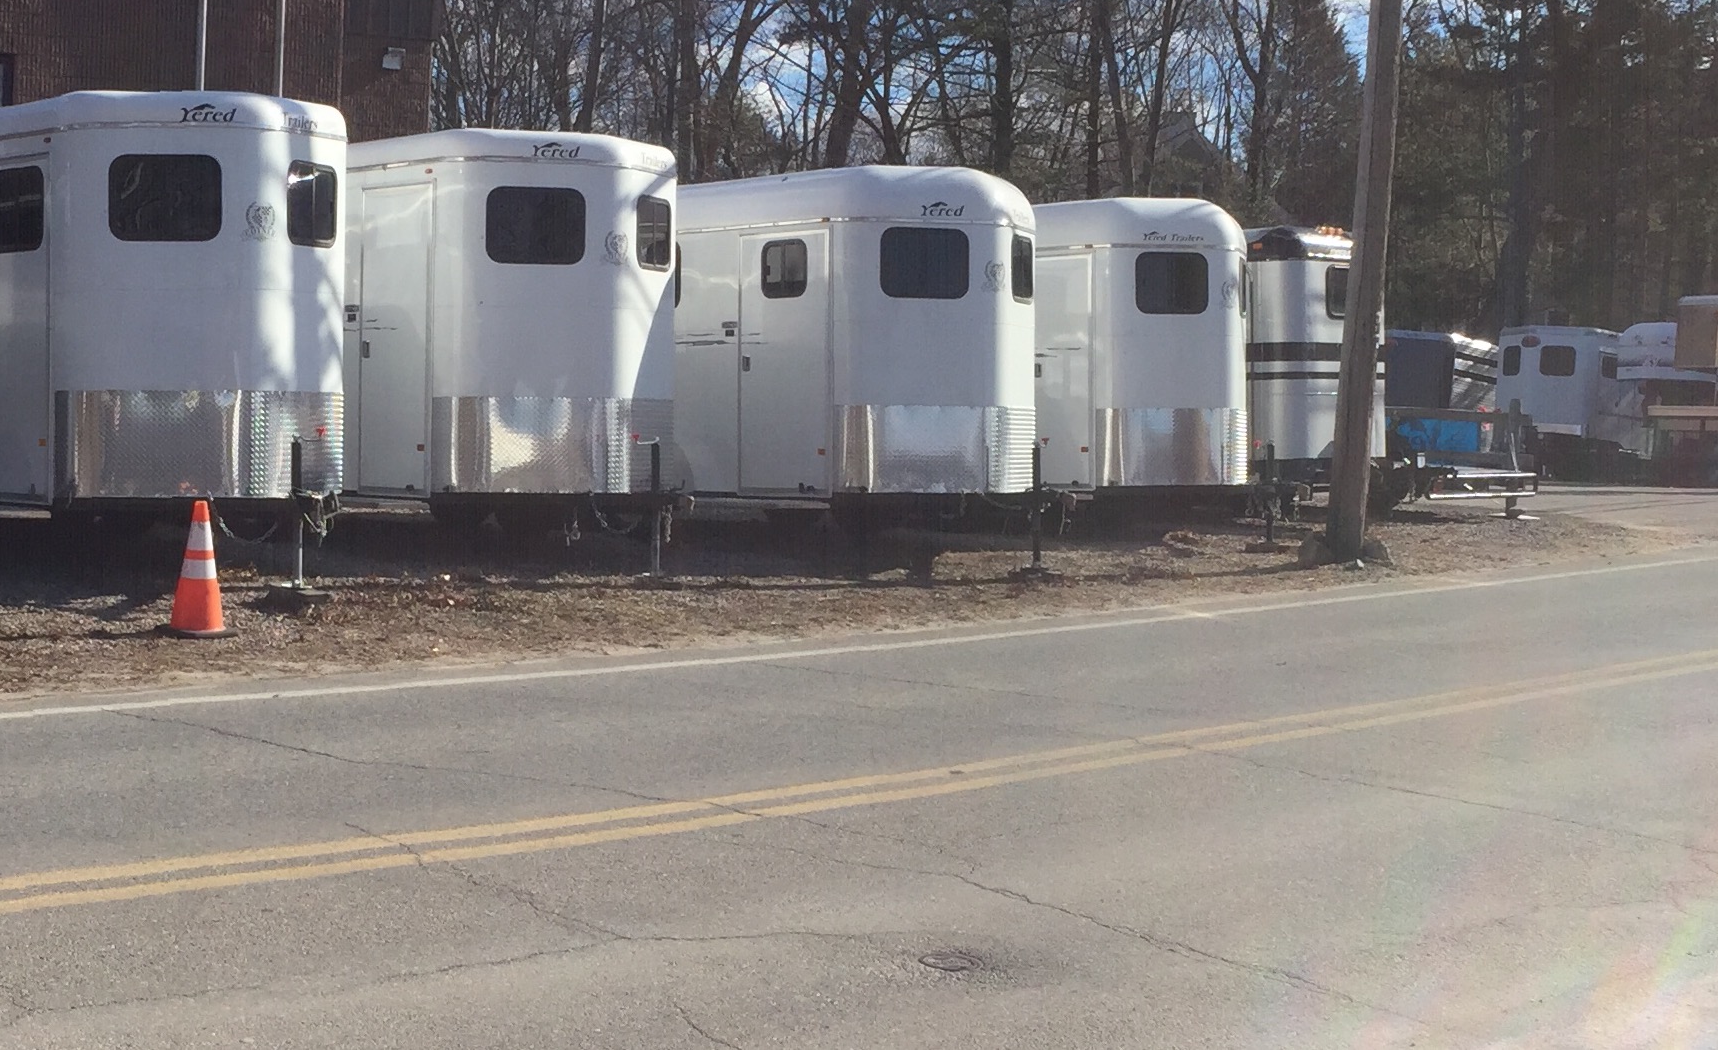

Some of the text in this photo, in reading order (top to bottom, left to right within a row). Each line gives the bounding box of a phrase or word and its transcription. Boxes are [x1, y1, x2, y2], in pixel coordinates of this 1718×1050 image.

[179, 103, 318, 131] Yered Trailers
[532, 142, 581, 158] Yered
[920, 201, 965, 217] Yered
[1142, 231, 1204, 242] Yered Trailers
